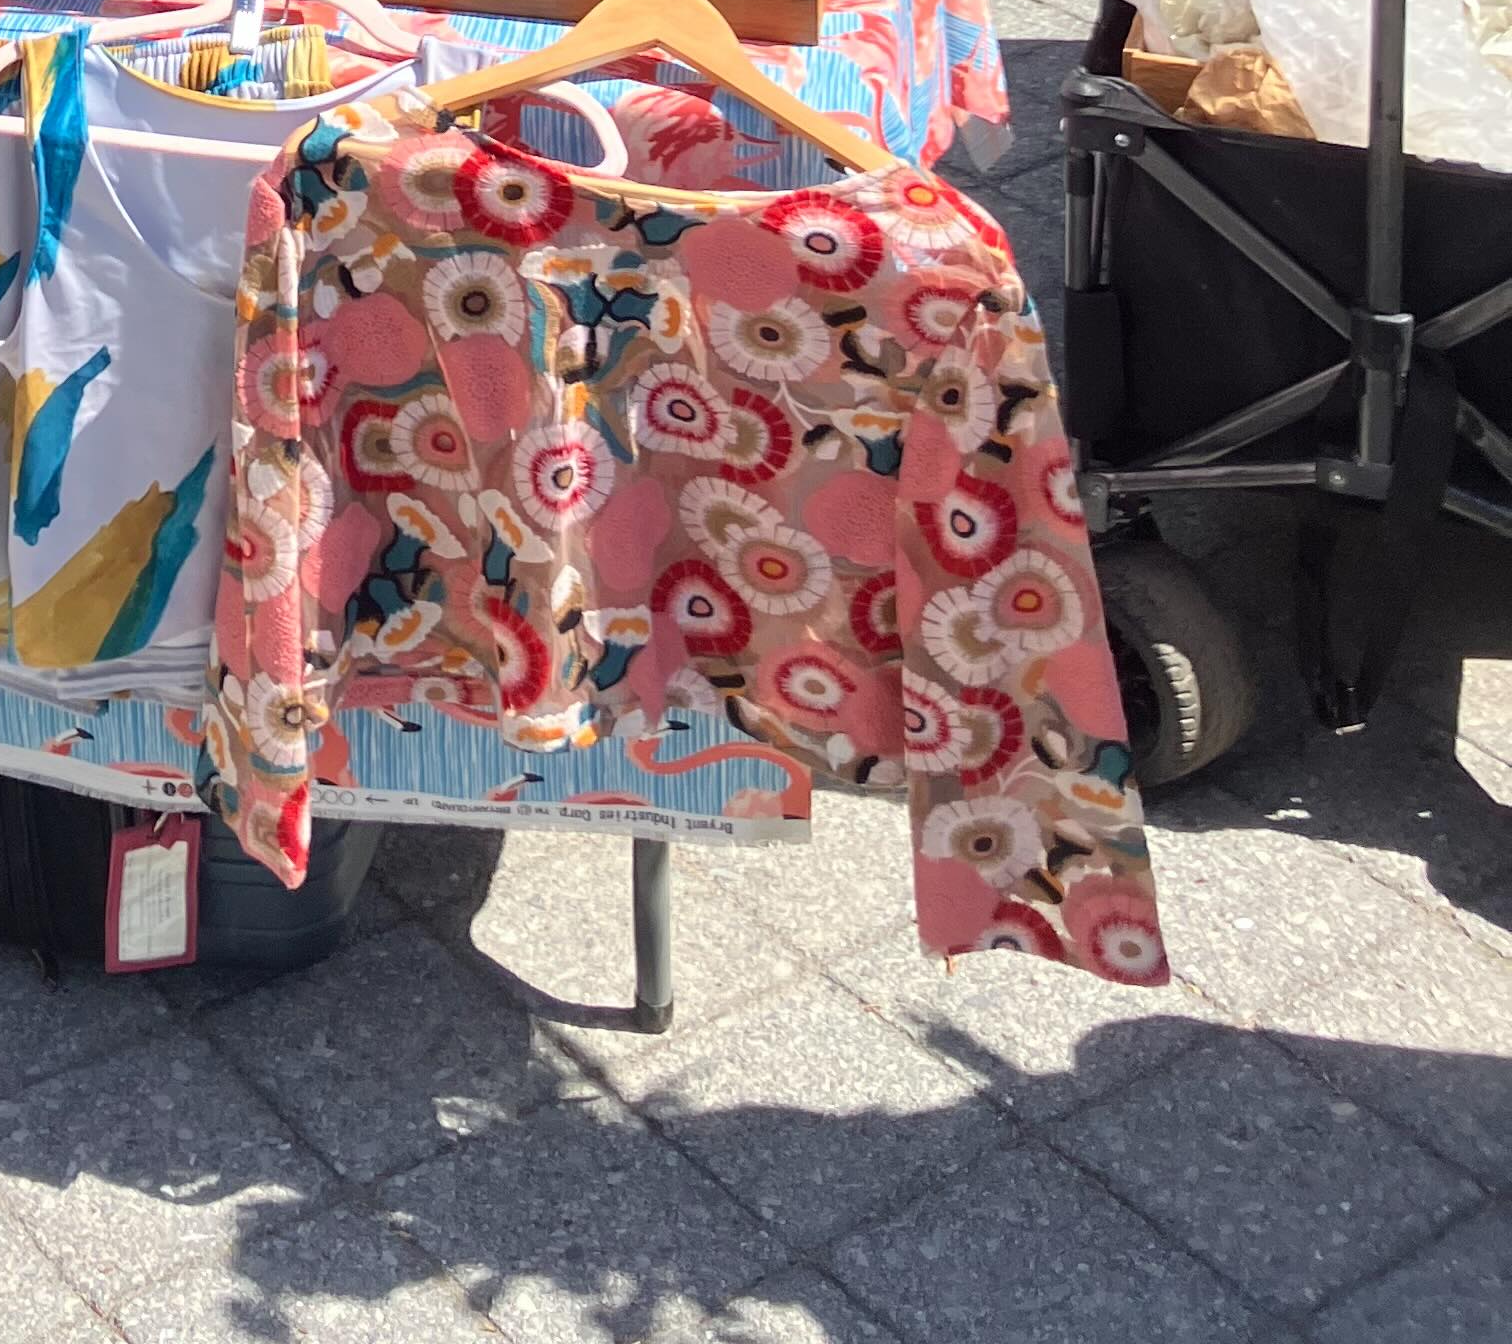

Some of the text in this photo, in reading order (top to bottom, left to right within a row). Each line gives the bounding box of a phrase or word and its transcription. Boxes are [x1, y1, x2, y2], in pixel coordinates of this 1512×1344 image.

[557, 807, 592, 822] Corp.
[599, 809, 677, 829] Industries
[684, 817, 734, 835] Bryant
